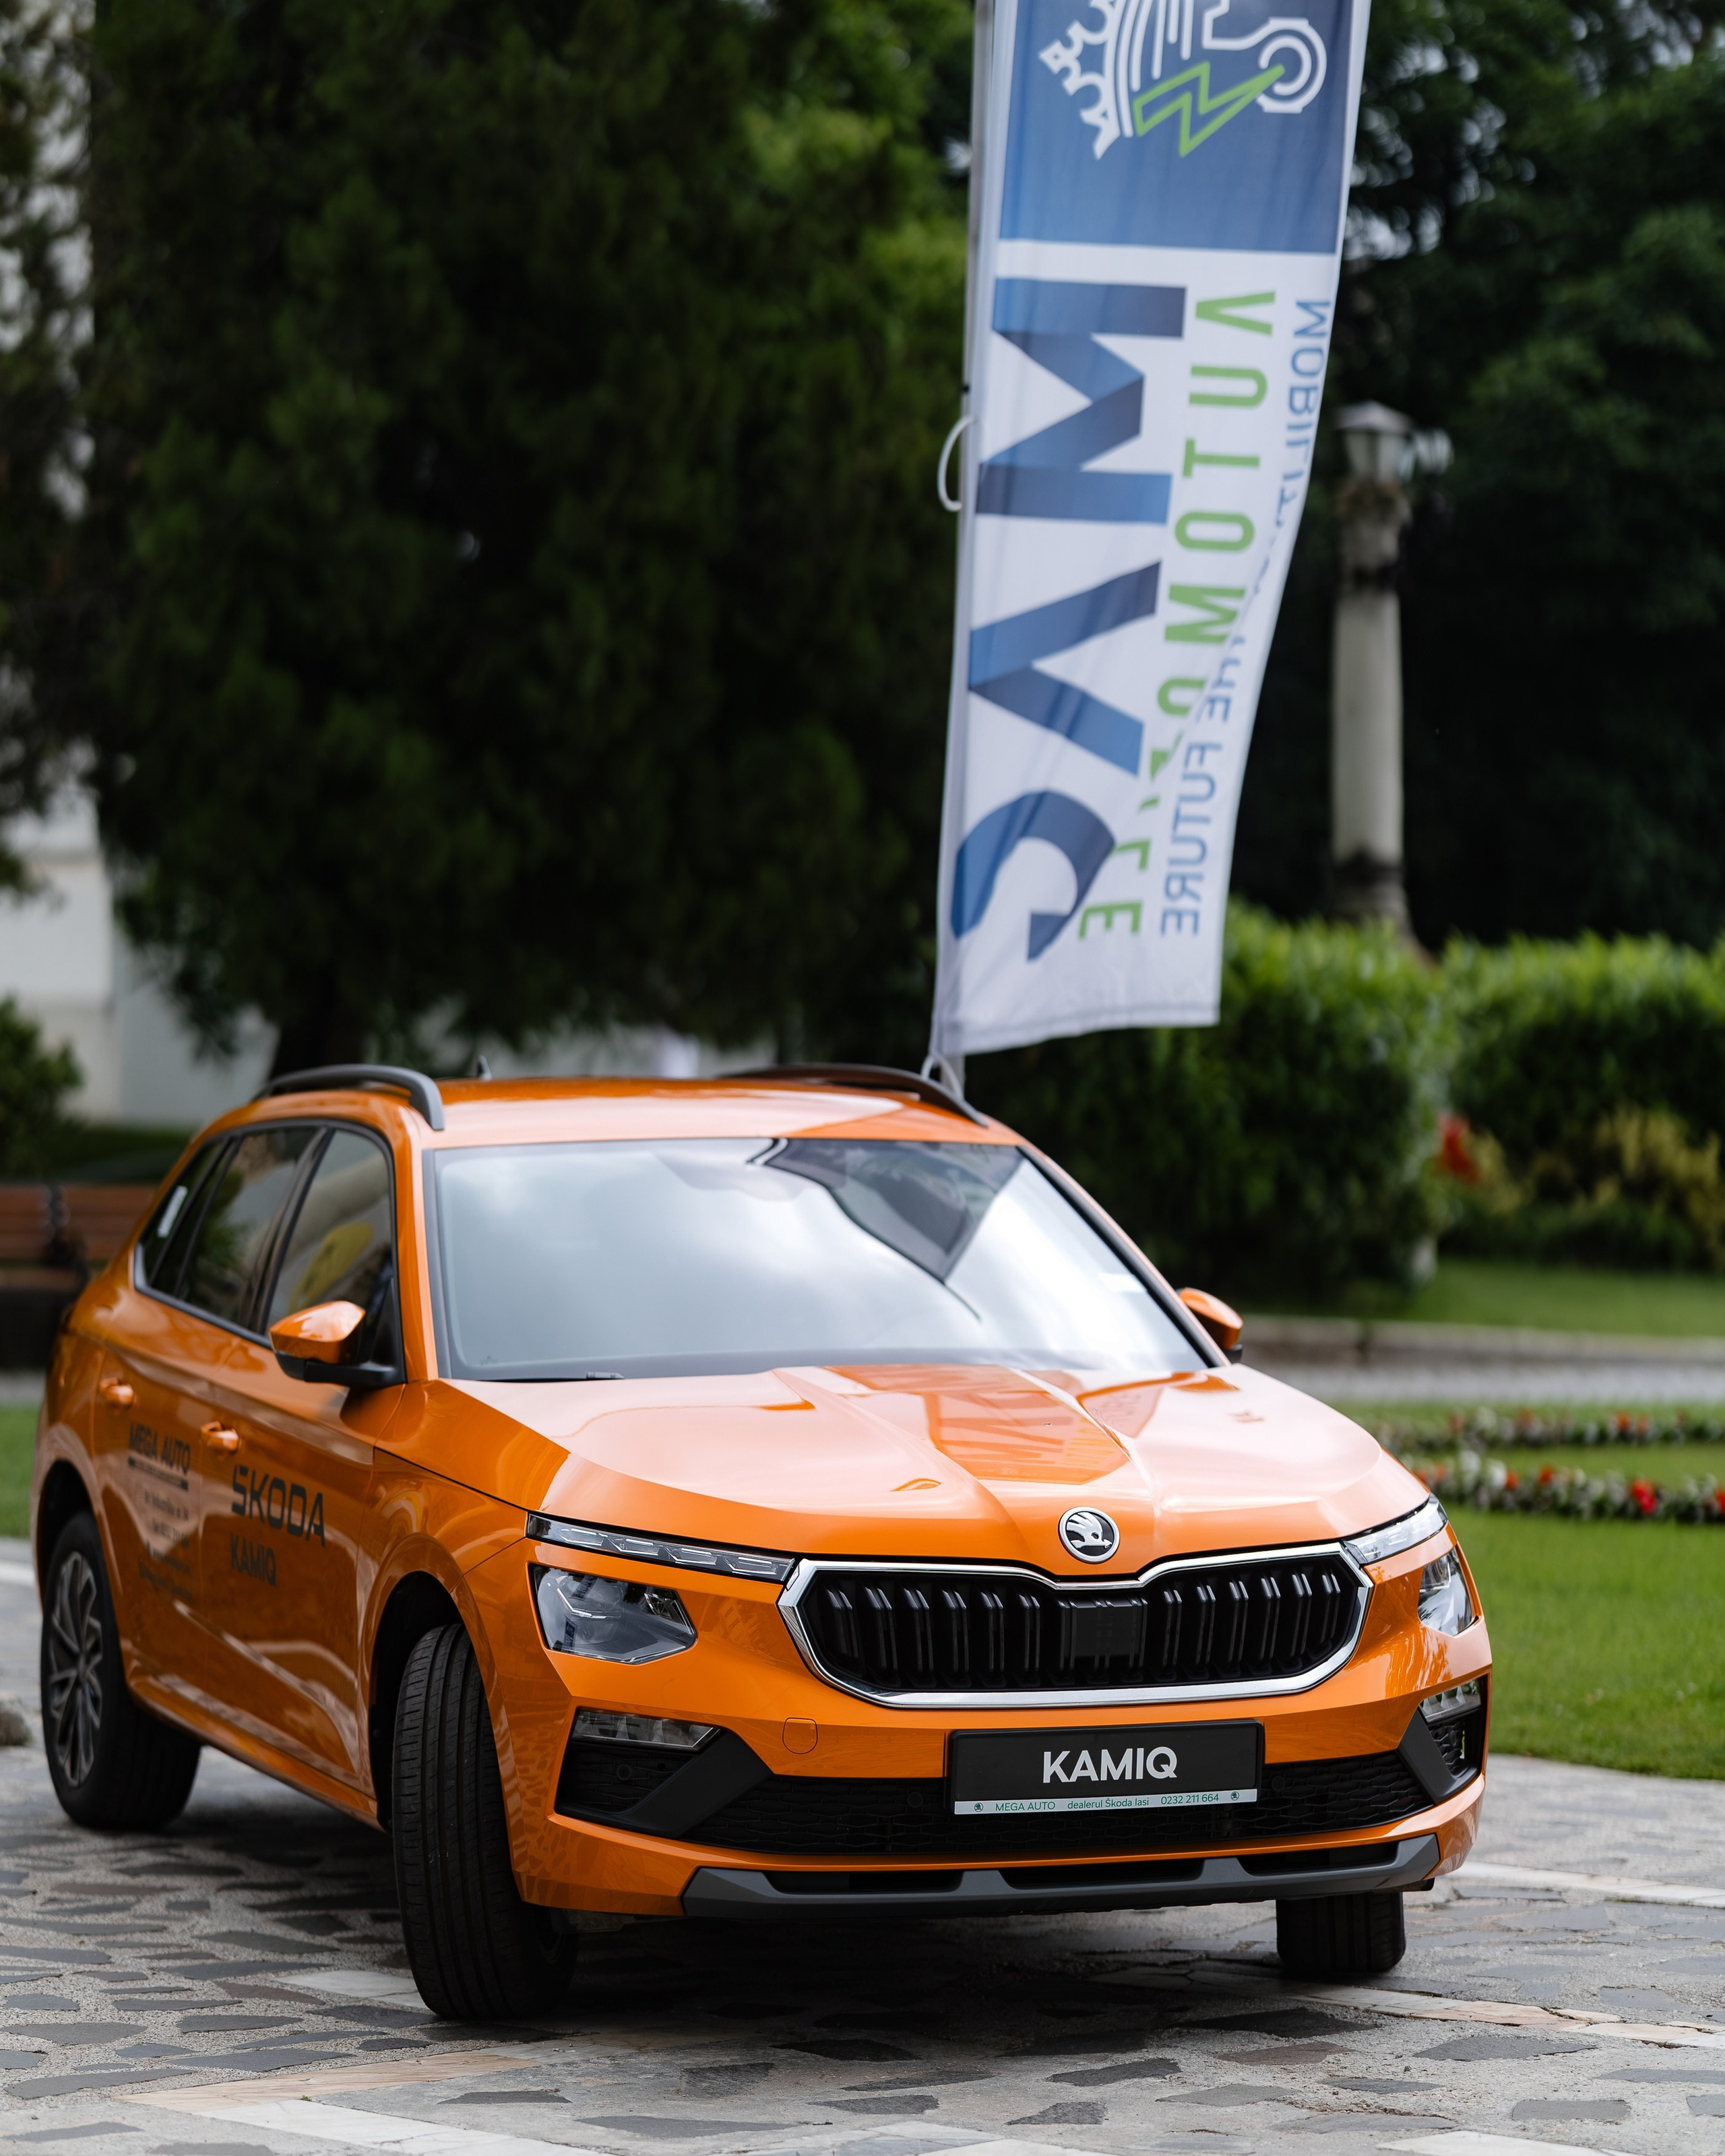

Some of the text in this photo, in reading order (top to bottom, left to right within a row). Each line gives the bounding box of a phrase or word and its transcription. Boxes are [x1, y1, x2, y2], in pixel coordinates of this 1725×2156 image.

[128, 1421, 158, 1461] MEGA
[160, 1434, 191, 1476] AUTO
[230, 1533, 277, 1587] KAMIQ
[1043, 1746, 1178, 1783] KAMIQ
[995, 1802, 1025, 1812] MEGA
[1027, 1801, 1056, 1811] AUTO
[1067, 1799, 1102, 1810] dealerul
[1105, 1798, 1133, 1808] Škoda
[1160, 1795, 1183, 1805] 0232
[1185, 1794, 1199, 1804] 211
[1201, 1793, 1219, 1802] 664
